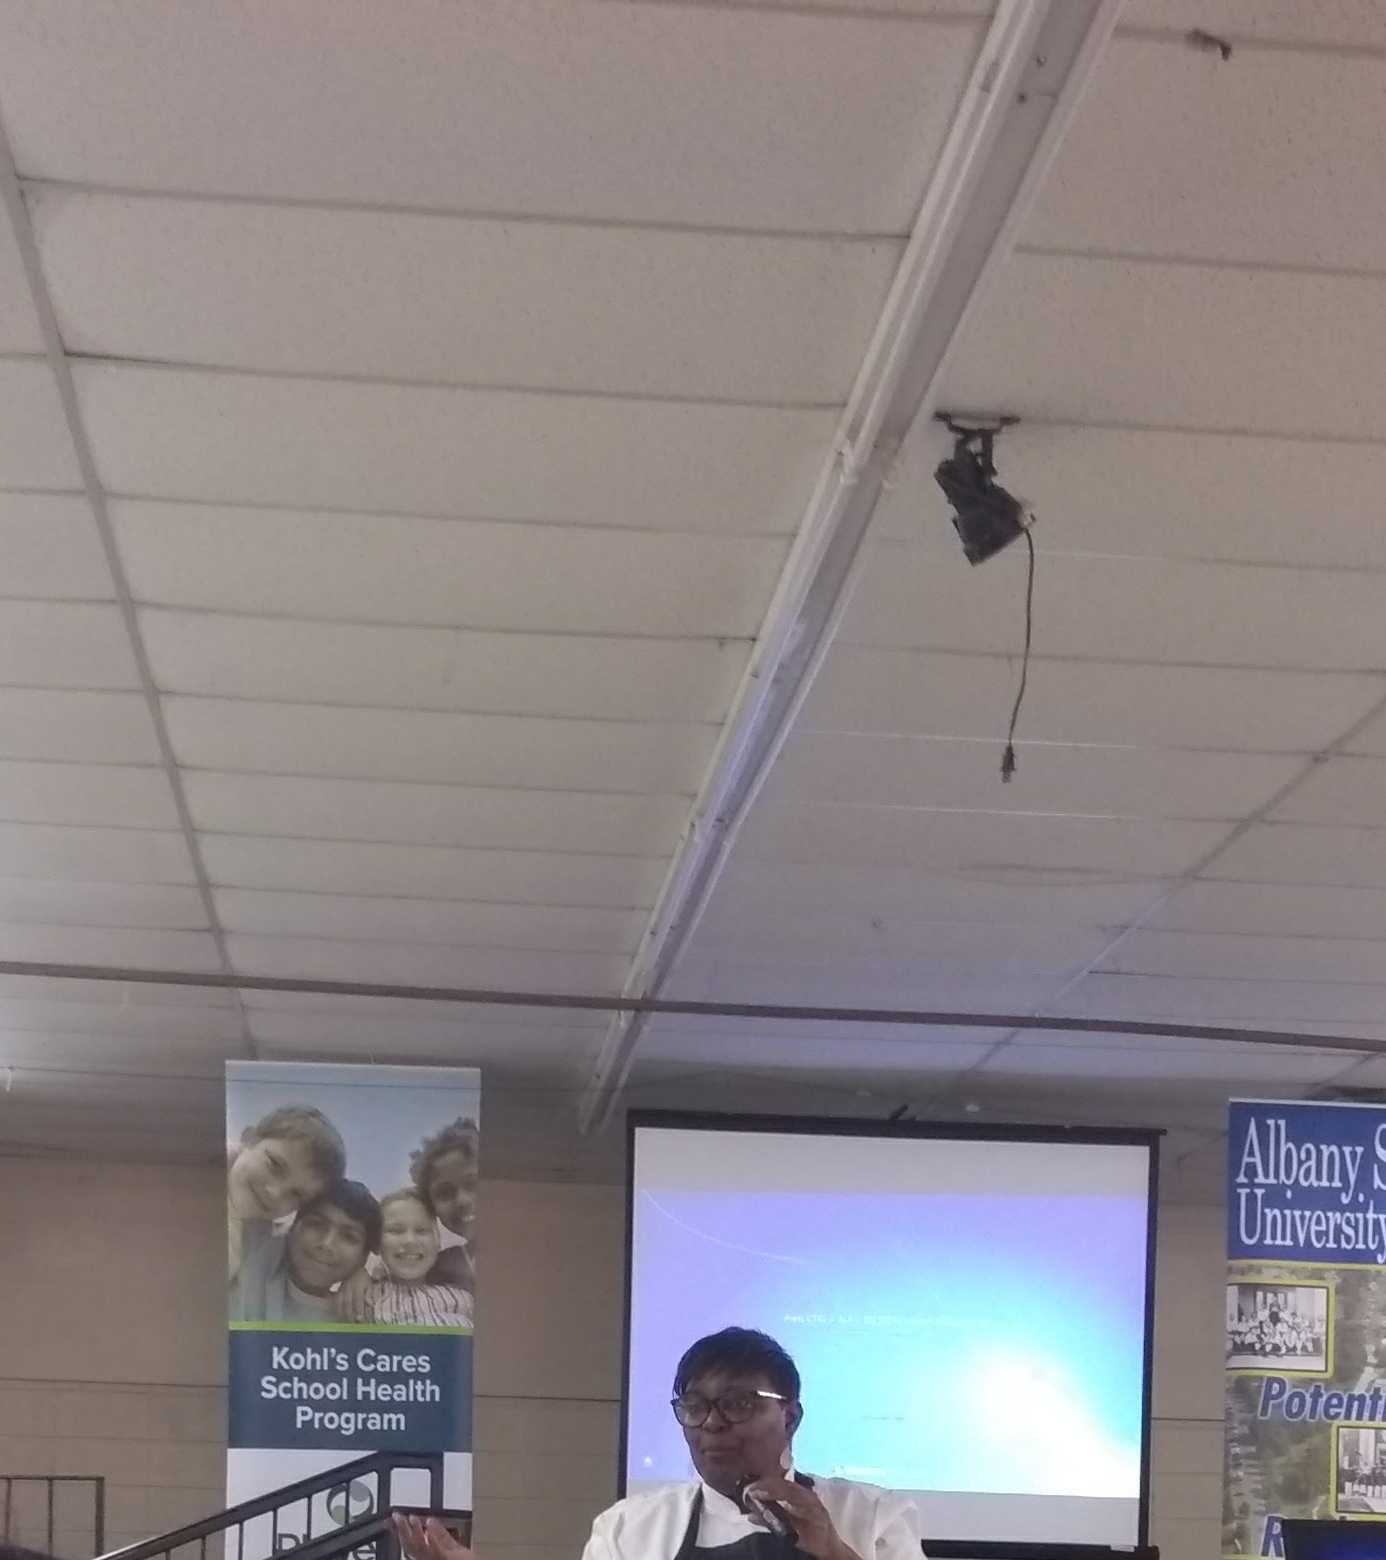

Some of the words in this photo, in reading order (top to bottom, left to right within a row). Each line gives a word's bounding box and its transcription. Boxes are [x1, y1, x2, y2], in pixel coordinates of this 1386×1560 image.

[1236, 1117, 1364, 1204] Albany
[272, 1346, 349, 1371] Kohl's
[356, 1348, 431, 1373] Cares
[260, 1375, 348, 1400] School
[357, 1378, 440, 1402] Health
[296, 1406, 406, 1435] Program
